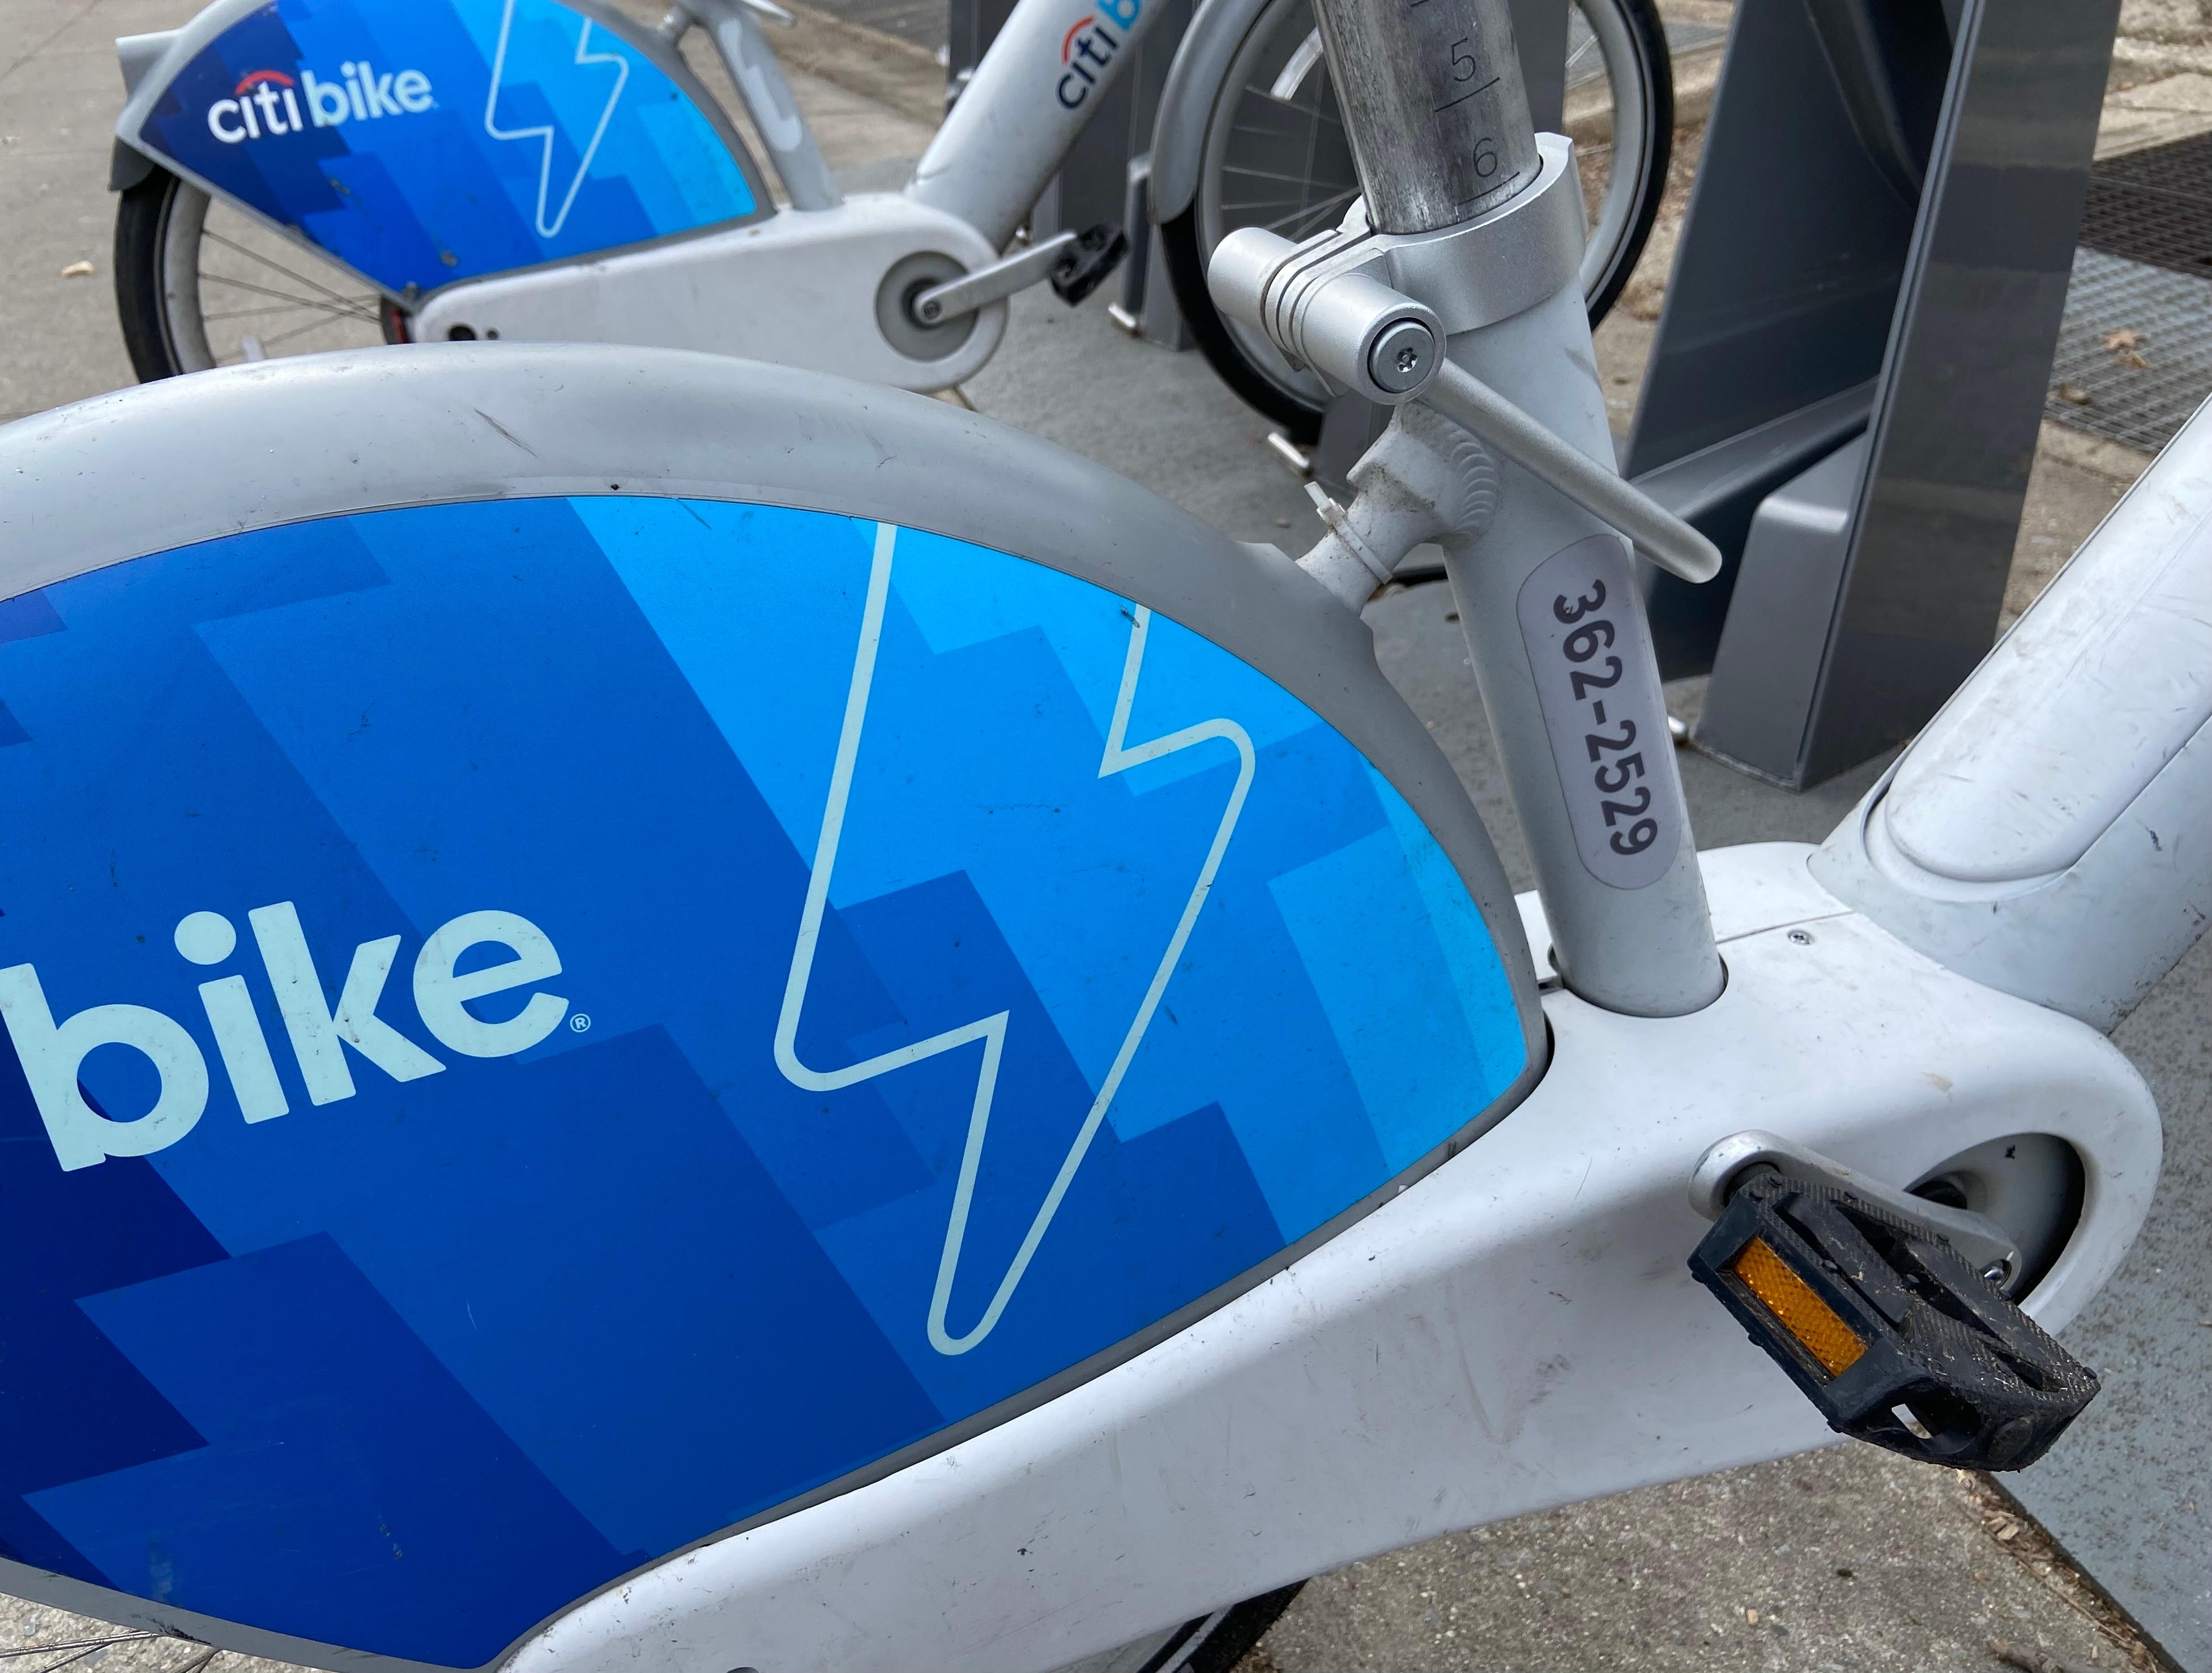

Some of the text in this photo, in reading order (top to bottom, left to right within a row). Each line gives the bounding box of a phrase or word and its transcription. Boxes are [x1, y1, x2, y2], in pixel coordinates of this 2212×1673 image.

[208, 60, 434, 144] citi bike
[1056, 14, 1119, 110] citi
[1451, 37, 1477, 83] 5
[1472, 137, 1498, 178] 6
[1552, 579, 1659, 856] 362-2529
